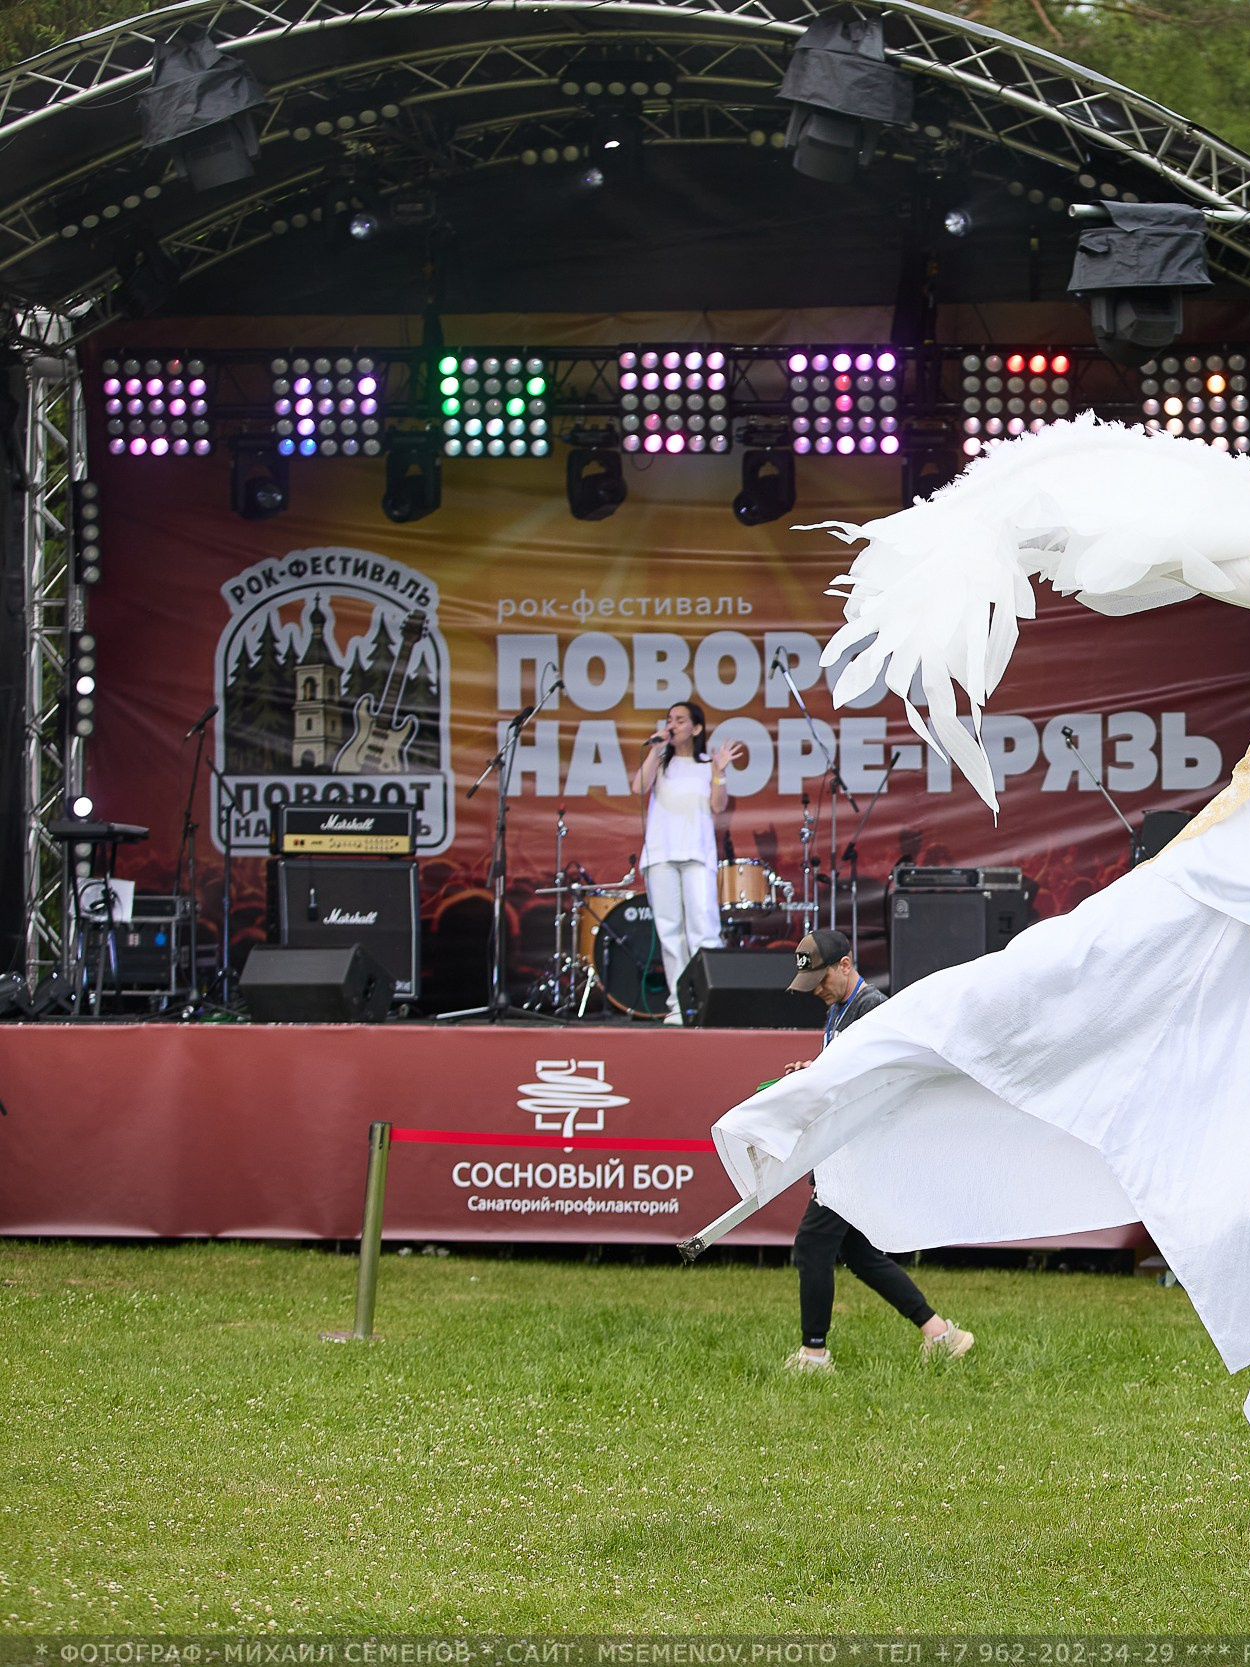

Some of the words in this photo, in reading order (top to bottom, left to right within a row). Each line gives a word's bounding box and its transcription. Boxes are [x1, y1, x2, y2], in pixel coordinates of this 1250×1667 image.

[229, 554, 432, 607] РОК-ФЕСТИВАЛЬ
[497, 589, 753, 623] рок-фестиваль
[496, 718, 632, 798] НА
[656, 710, 1223, 798] ОРЕ-ГРЯЗЬ
[320, 813, 376, 832] Marshall
[322, 907, 379, 925] Marshall
[451, 1157, 625, 1190] СОСНОВЫЙ
[632, 1164, 695, 1190] БОР
[466, 1195, 680, 1216] Санаторий-профилакторий
